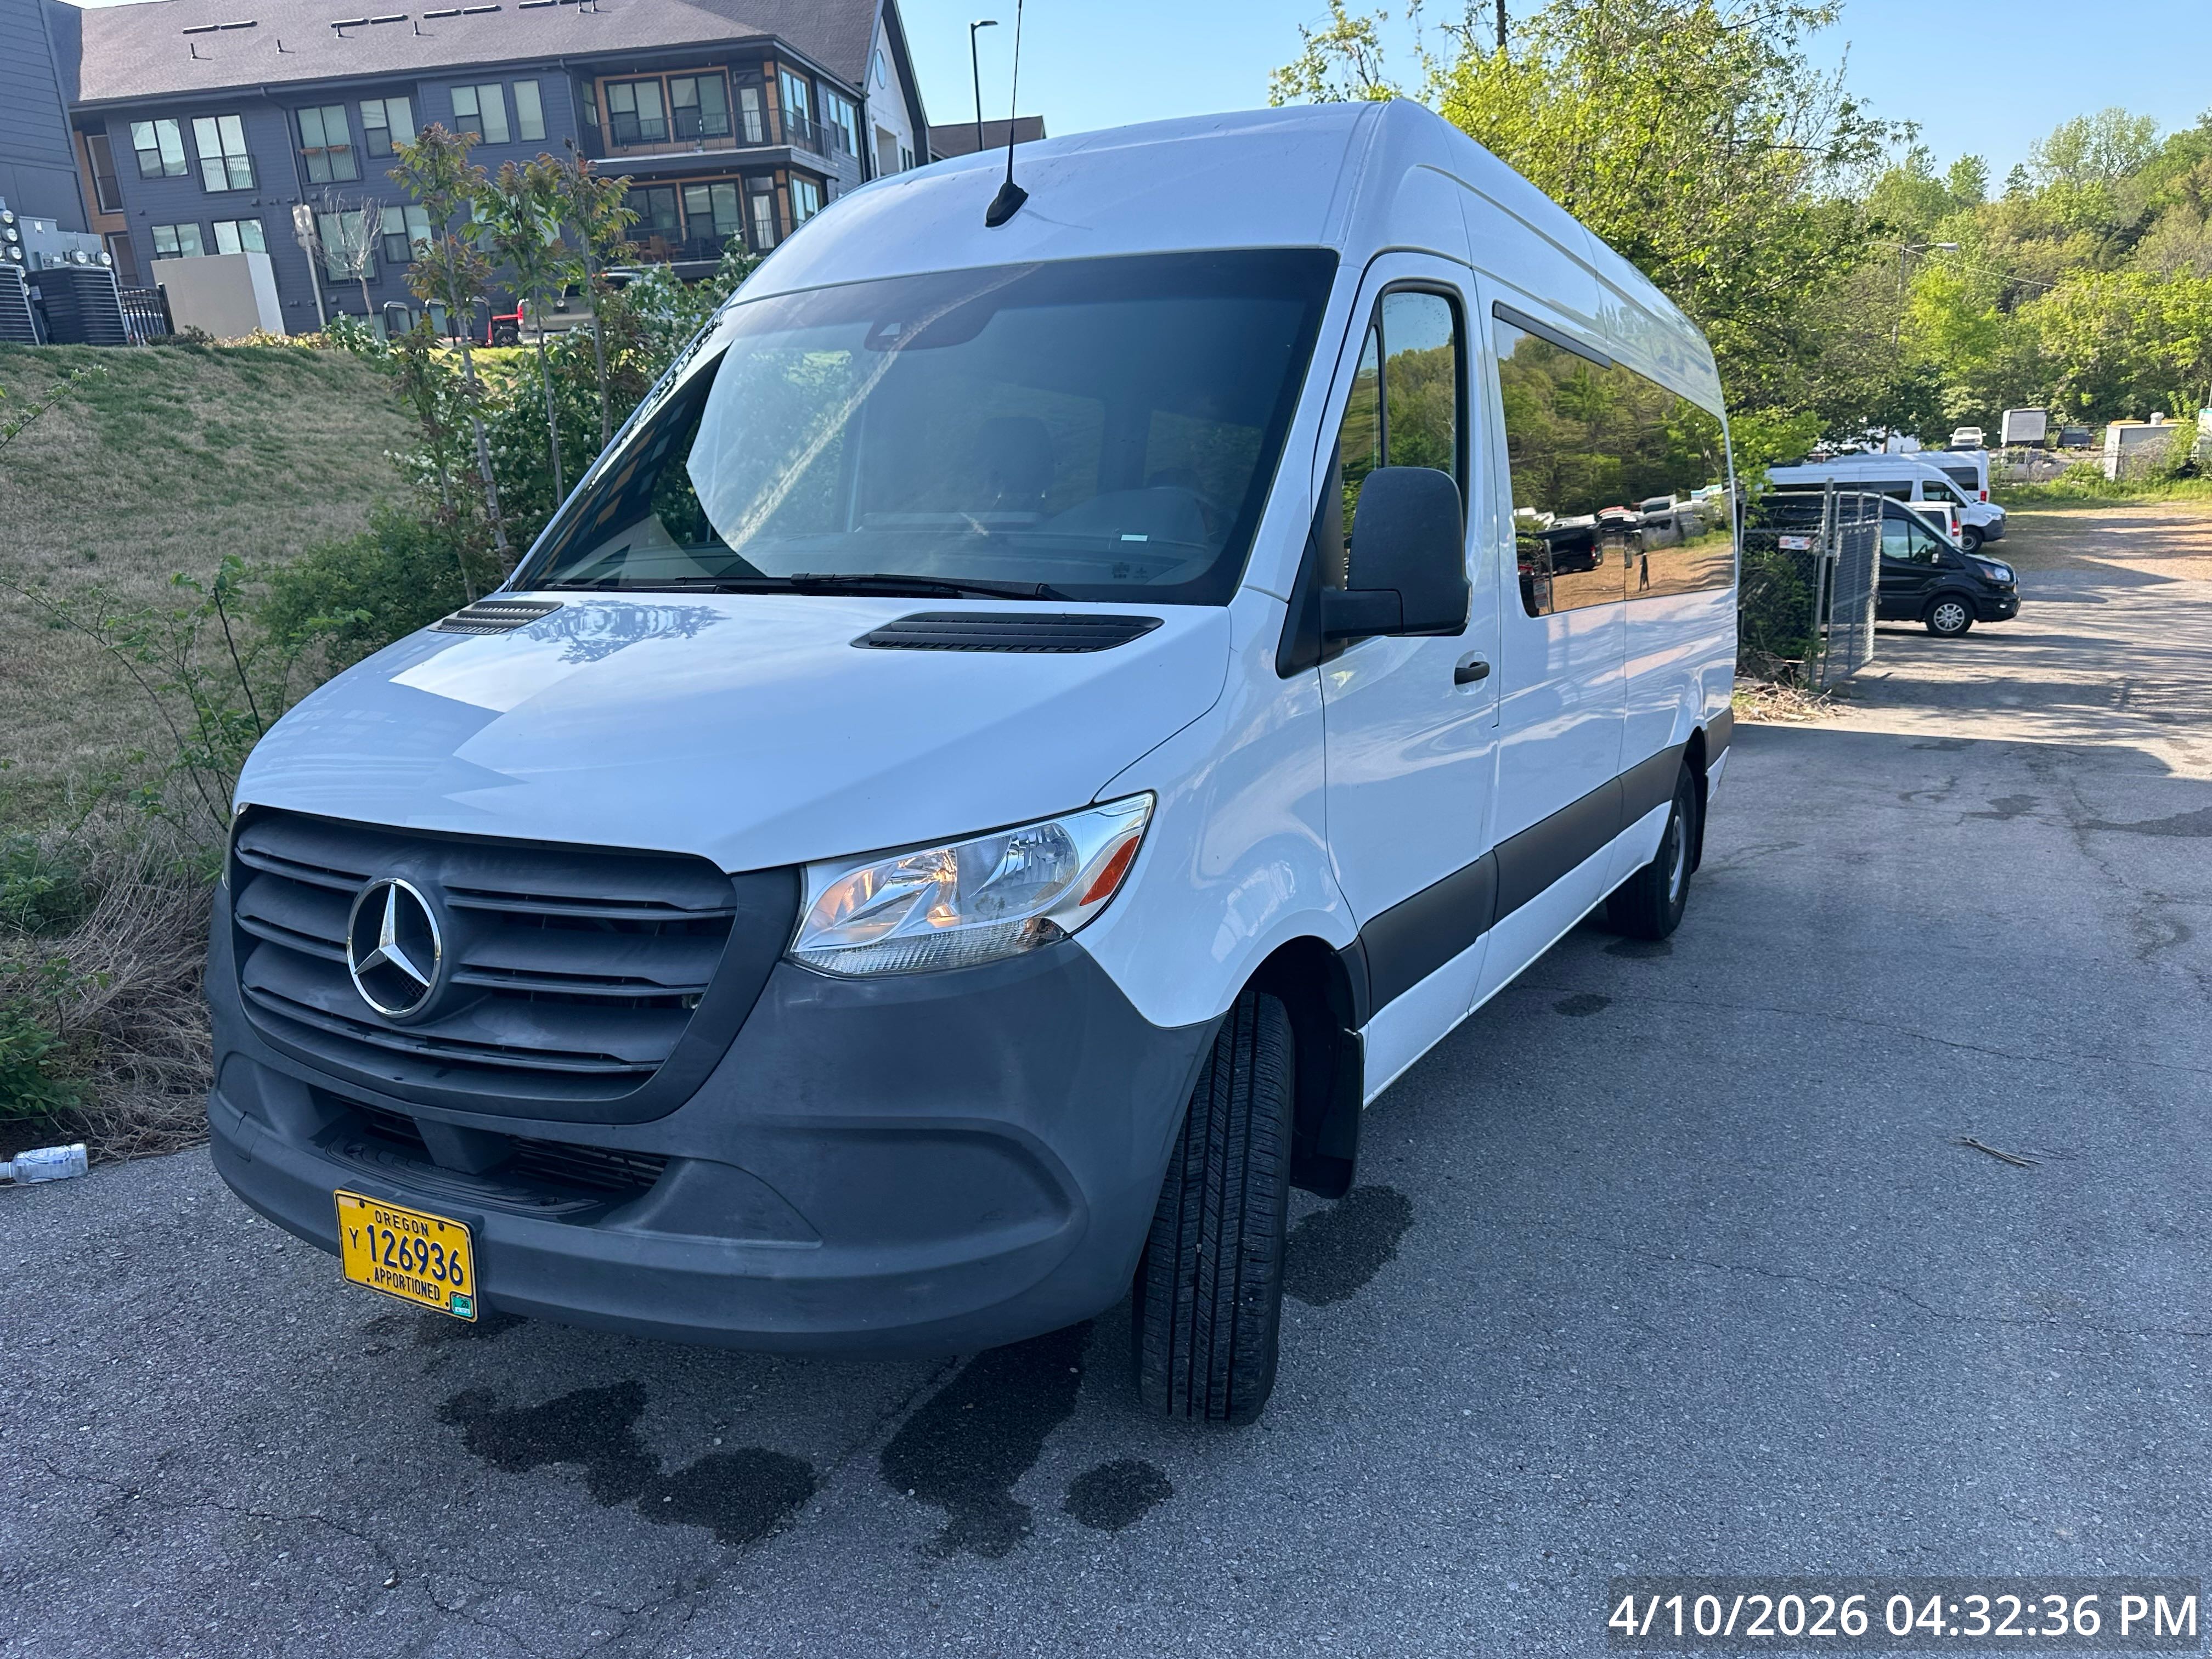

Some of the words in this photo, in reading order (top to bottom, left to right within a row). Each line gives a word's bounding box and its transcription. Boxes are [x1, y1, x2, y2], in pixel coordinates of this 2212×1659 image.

[375, 1210, 429, 1237] OREGON
[349, 1226, 358, 1249] Y
[367, 1224, 464, 1286] 126936
[374, 1266, 440, 1301] APPORTIONED
[461, 1299, 469, 1308] 26
